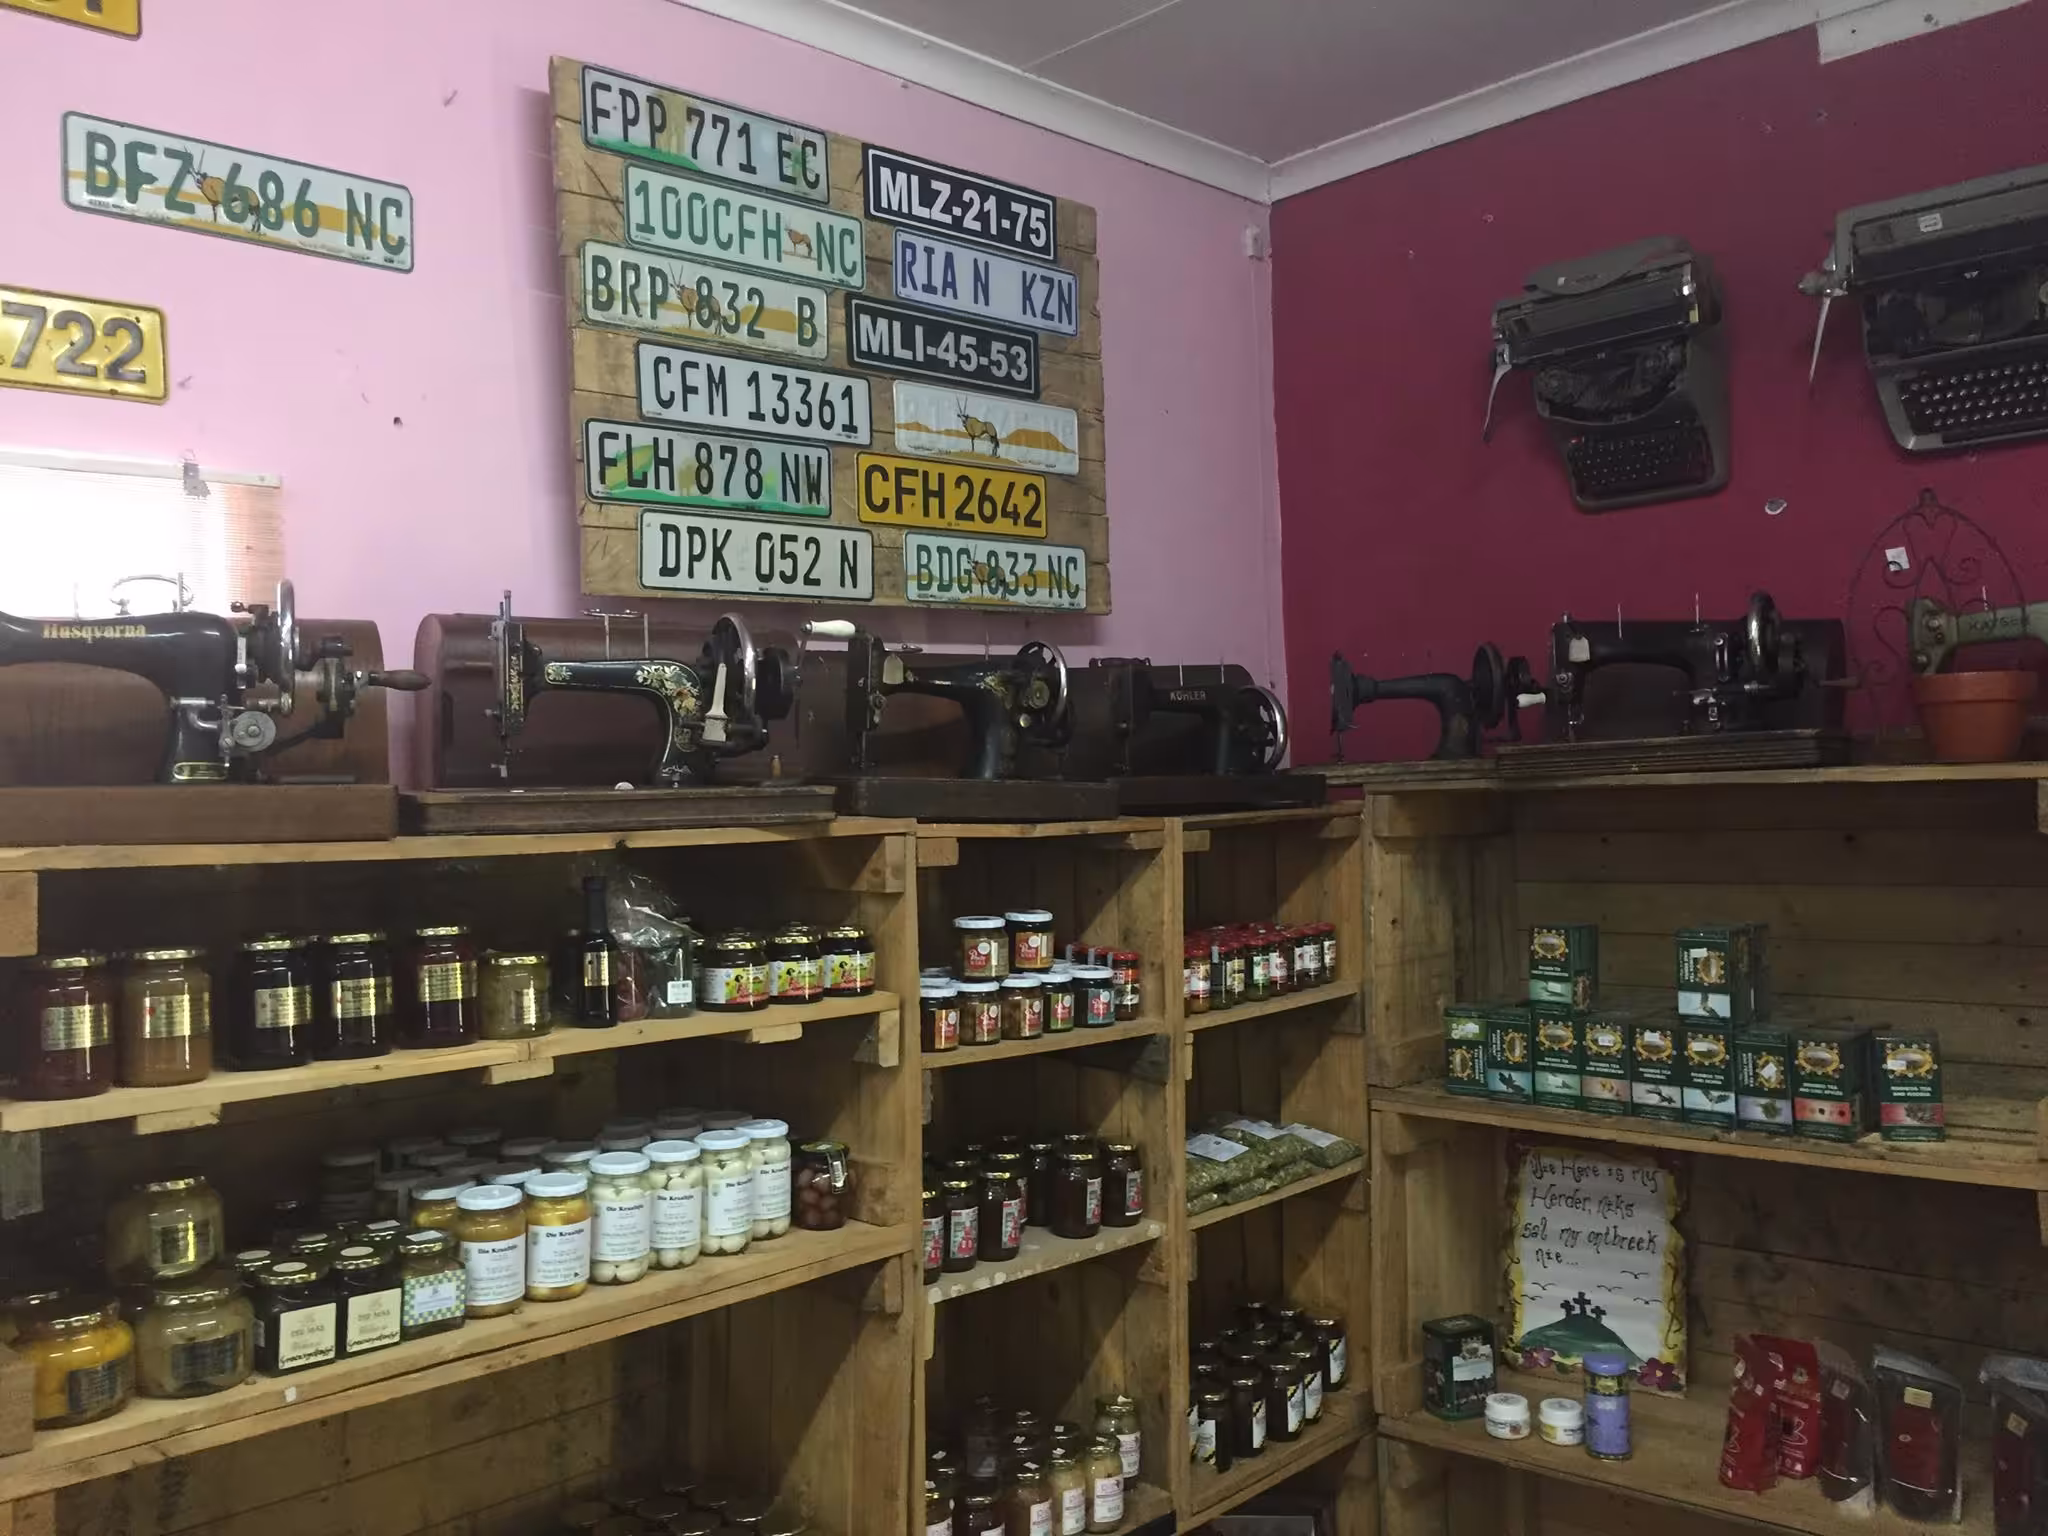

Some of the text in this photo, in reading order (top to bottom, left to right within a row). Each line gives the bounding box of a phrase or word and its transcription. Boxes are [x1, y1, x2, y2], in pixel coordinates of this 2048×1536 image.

[590, 80, 821, 190] FPP 771 EC
[85, 130, 406, 256] BFZ 686 NC
[879, 165, 1048, 249] MLZ-21-75
[815, 221, 858, 278] NC
[900, 239, 959, 301] RIA
[1021, 269, 1073, 327] KZN
[591, 253, 818, 348] BRP 832 B
[858, 312, 1029, 382] MLI-45-53
[652, 355, 730, 418] CFM
[746, 369, 859, 435] 13361
[597, 430, 823, 505] FLH 878 NW
[658, 522, 859, 589] DPK 052 N
[916, 543, 1081, 601] BDG 833 NC
[41, 622, 147, 642] Husqvarna
[1521, 1216, 1548, 1241] sal
